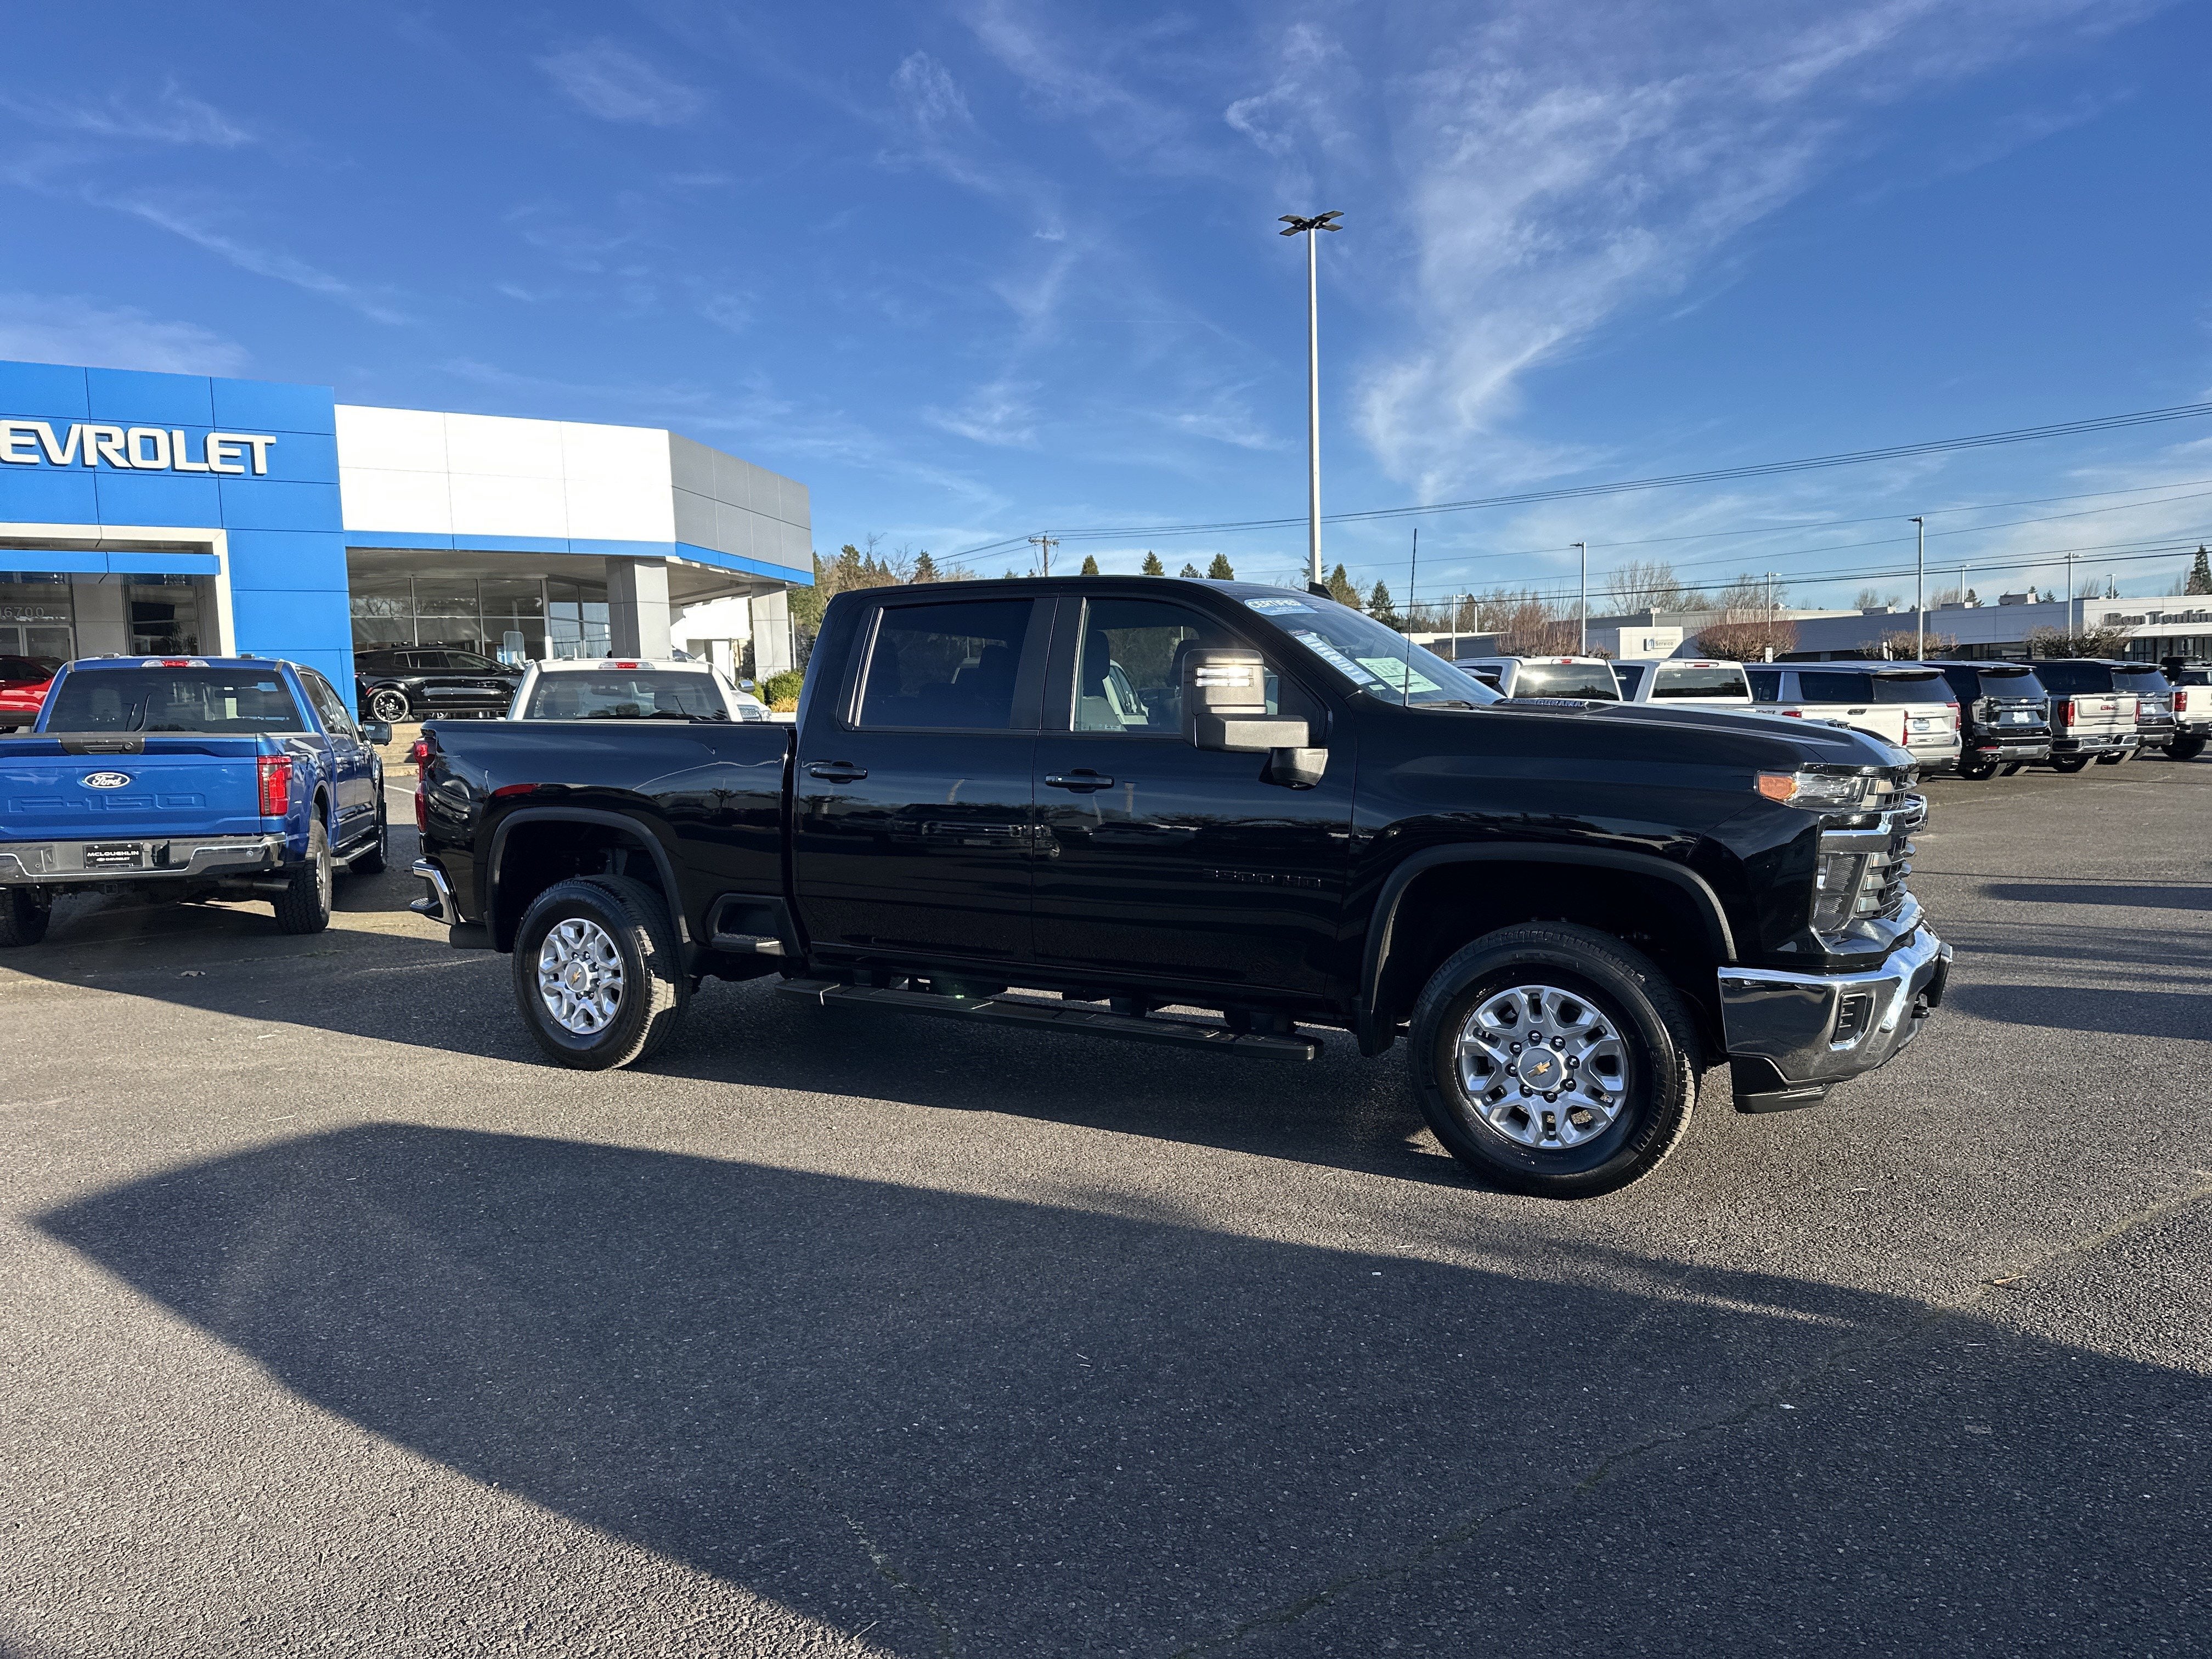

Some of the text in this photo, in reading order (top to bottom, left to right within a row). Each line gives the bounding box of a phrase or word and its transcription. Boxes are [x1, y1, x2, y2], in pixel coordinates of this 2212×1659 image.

[0, 606, 44, 618] 6700
[2104, 612, 2146, 627] Ron
[92, 774, 121, 786] Ford
[8, 793, 206, 812] F-150
